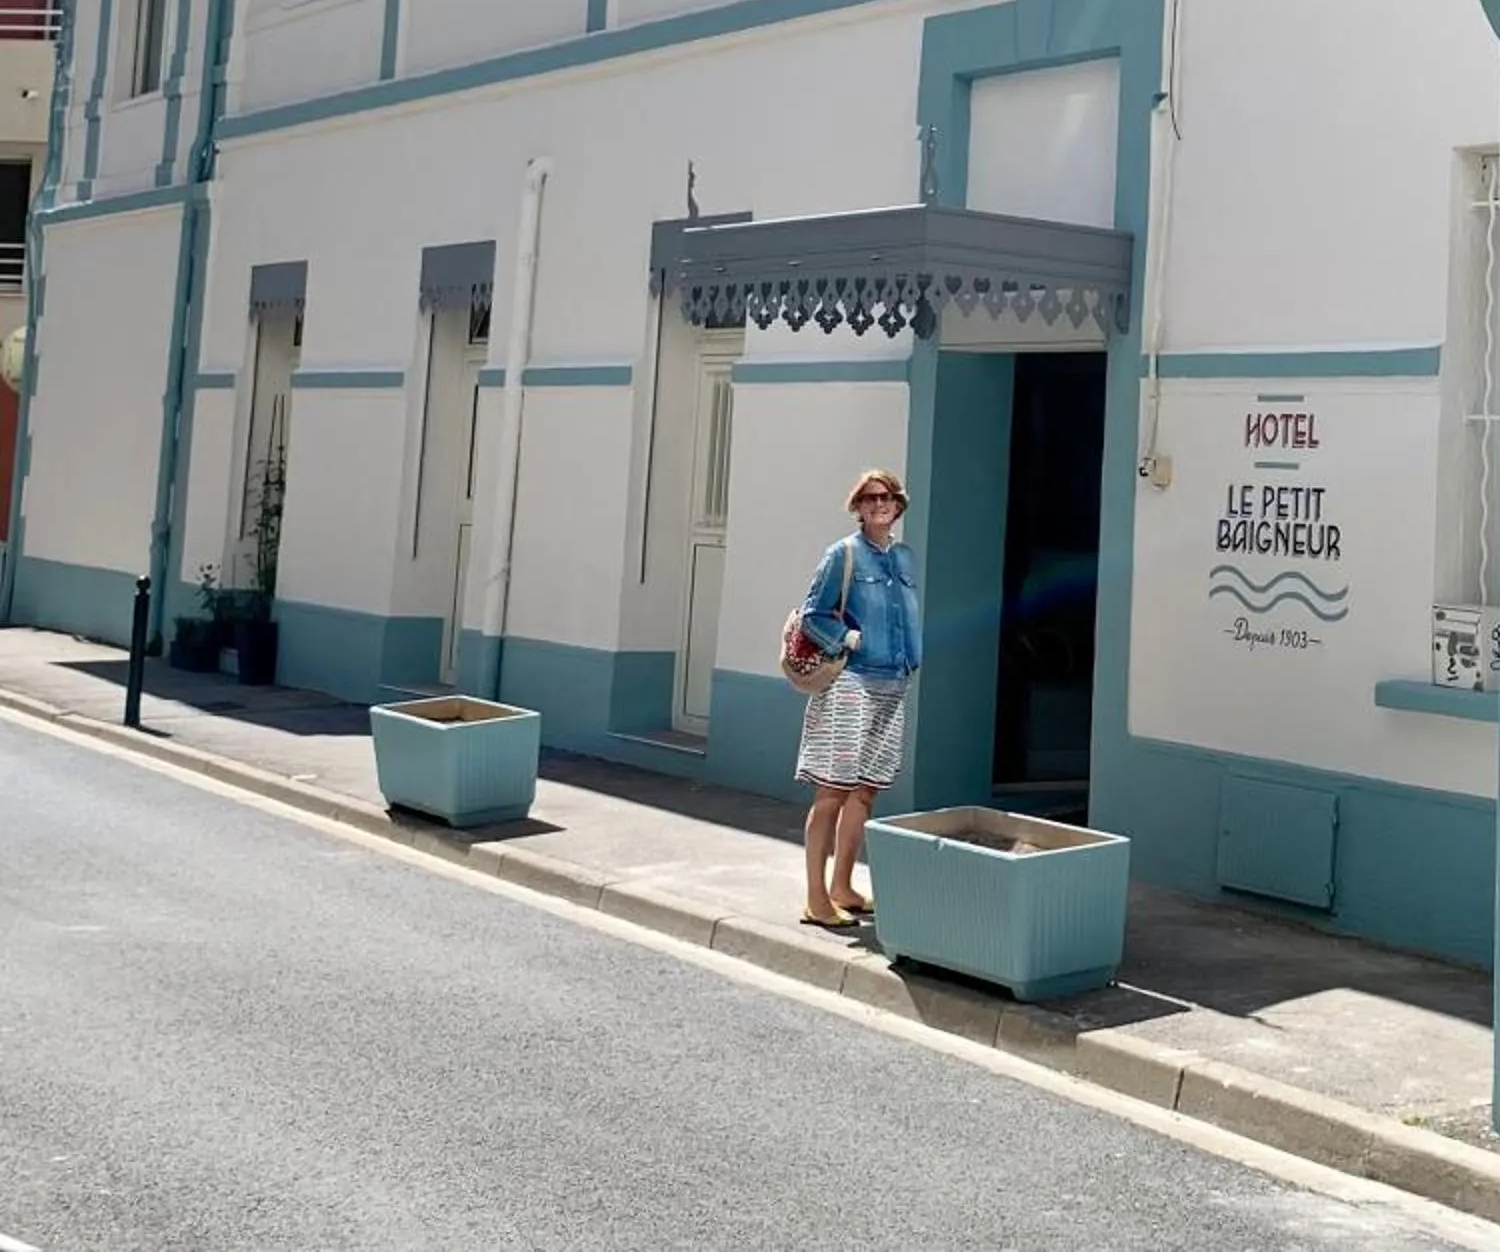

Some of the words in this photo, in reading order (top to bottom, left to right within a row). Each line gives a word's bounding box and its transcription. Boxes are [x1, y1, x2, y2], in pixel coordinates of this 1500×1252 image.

[1245, 413, 1320, 448] HOTEL
[1227, 485, 1254, 517] LE
[1261, 485, 1326, 522] PETIT
[1216, 519, 1342, 560] BAIGNEUR
